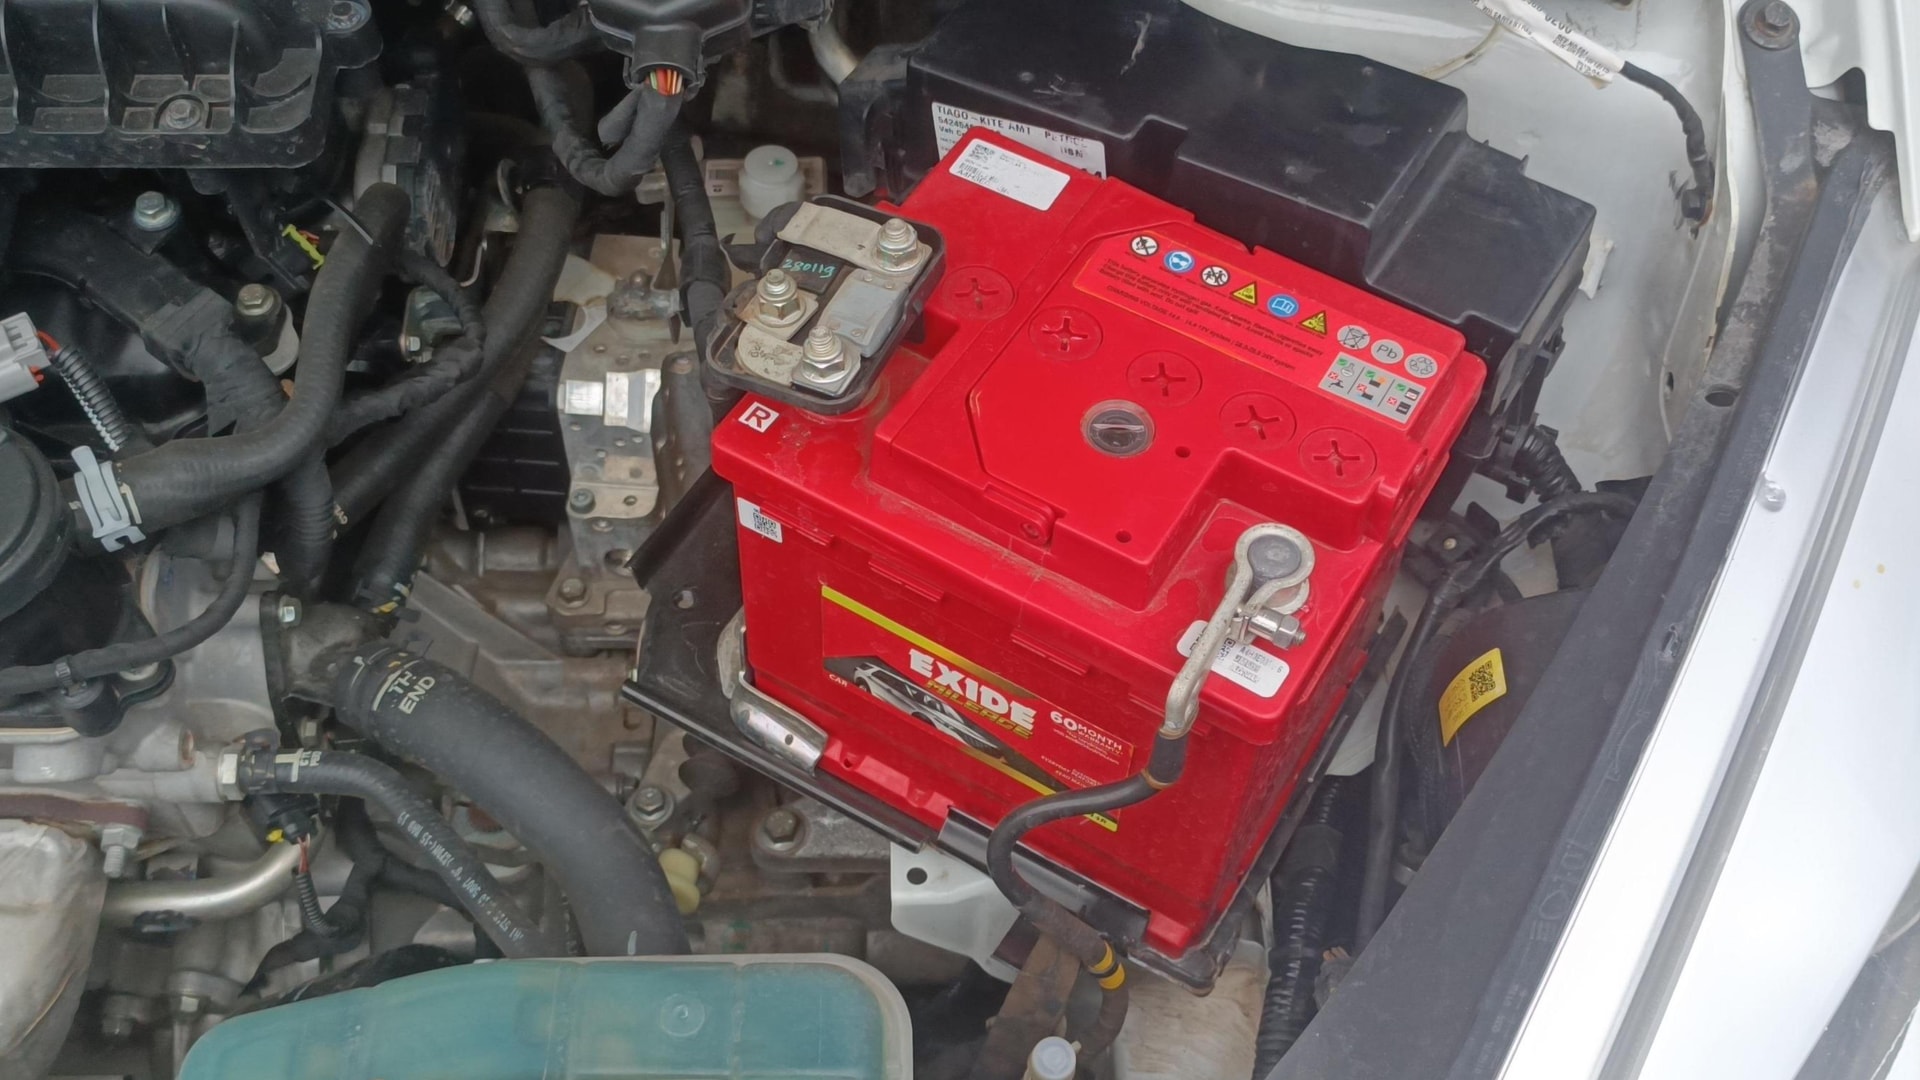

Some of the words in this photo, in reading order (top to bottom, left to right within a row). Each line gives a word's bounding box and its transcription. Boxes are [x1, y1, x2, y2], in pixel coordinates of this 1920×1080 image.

[937, 105, 969, 120] TIAGO
[979, 116, 1004, 129] KITE
[1008, 122, 1031, 135] AMT
[1106, 284, 1139, 302] CHARGING
[1140, 299, 1168, 314] VOLTAGE
[1376, 344, 1398, 360] Pb
[744, 405, 771, 429] R
[398, 676, 435, 714] END
[829, 673, 848, 688] CAR
[909, 649, 1036, 731] EXIDE
[926, 680, 1034, 740] MILEAGE
[1050, 710, 1077, 731] 60
[1078, 723, 1122, 751] MONTH
